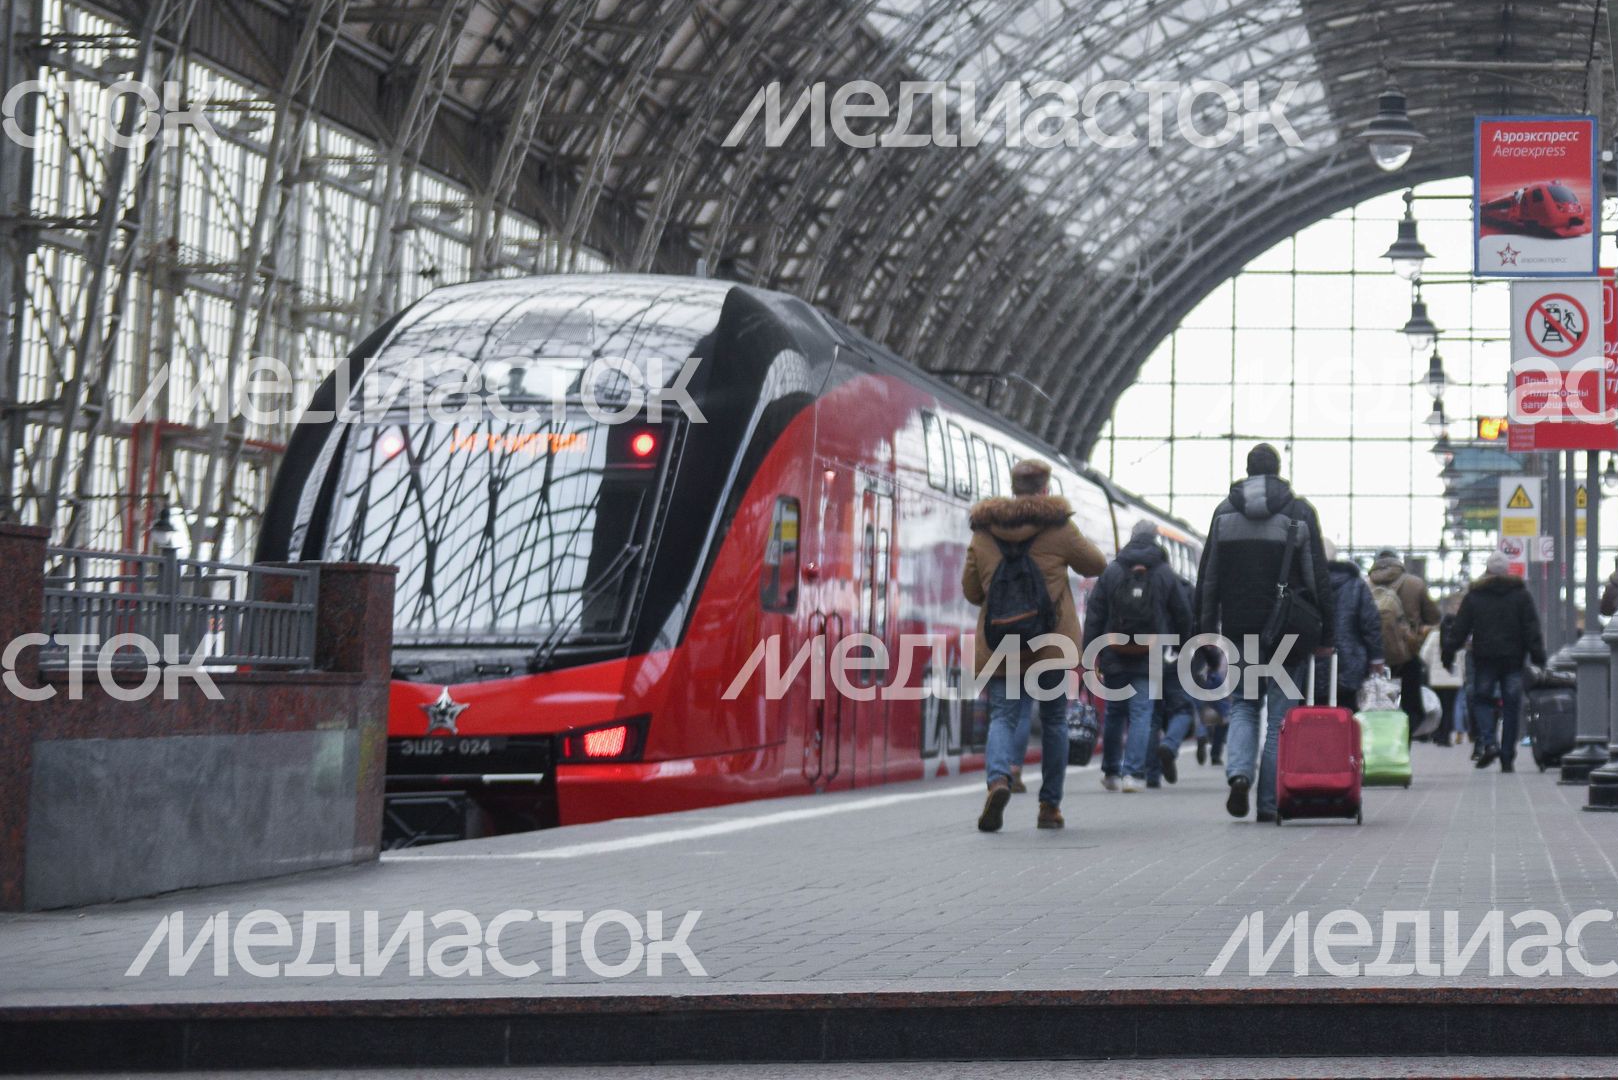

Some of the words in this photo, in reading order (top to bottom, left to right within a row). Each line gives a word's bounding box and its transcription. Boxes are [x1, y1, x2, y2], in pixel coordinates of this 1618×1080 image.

[1493, 130, 1580, 144] Аэроэкспресс
[1493, 145, 1567, 159] Aeroexpress
[401, 739, 443, 754] ЭШ2
[460, 739, 491, 754] 024
